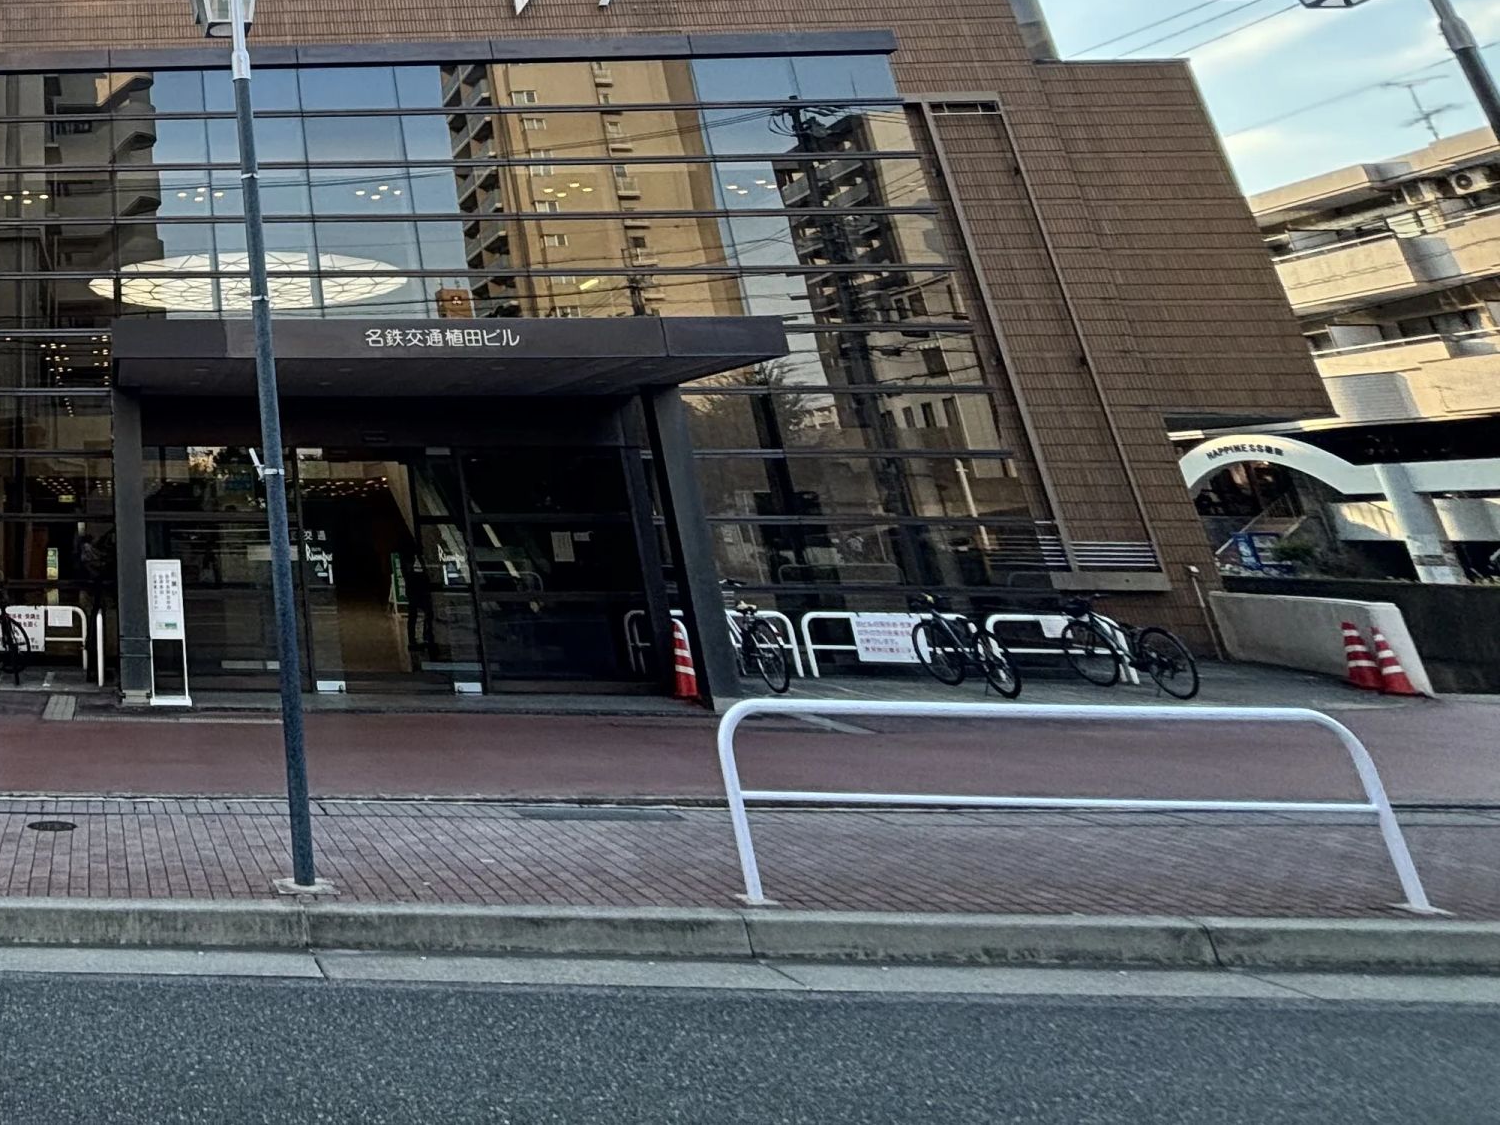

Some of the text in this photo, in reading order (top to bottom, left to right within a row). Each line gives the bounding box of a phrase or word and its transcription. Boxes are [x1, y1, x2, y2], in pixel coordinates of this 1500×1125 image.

[364, 328, 521, 348] 名鉄交通植田ビル
